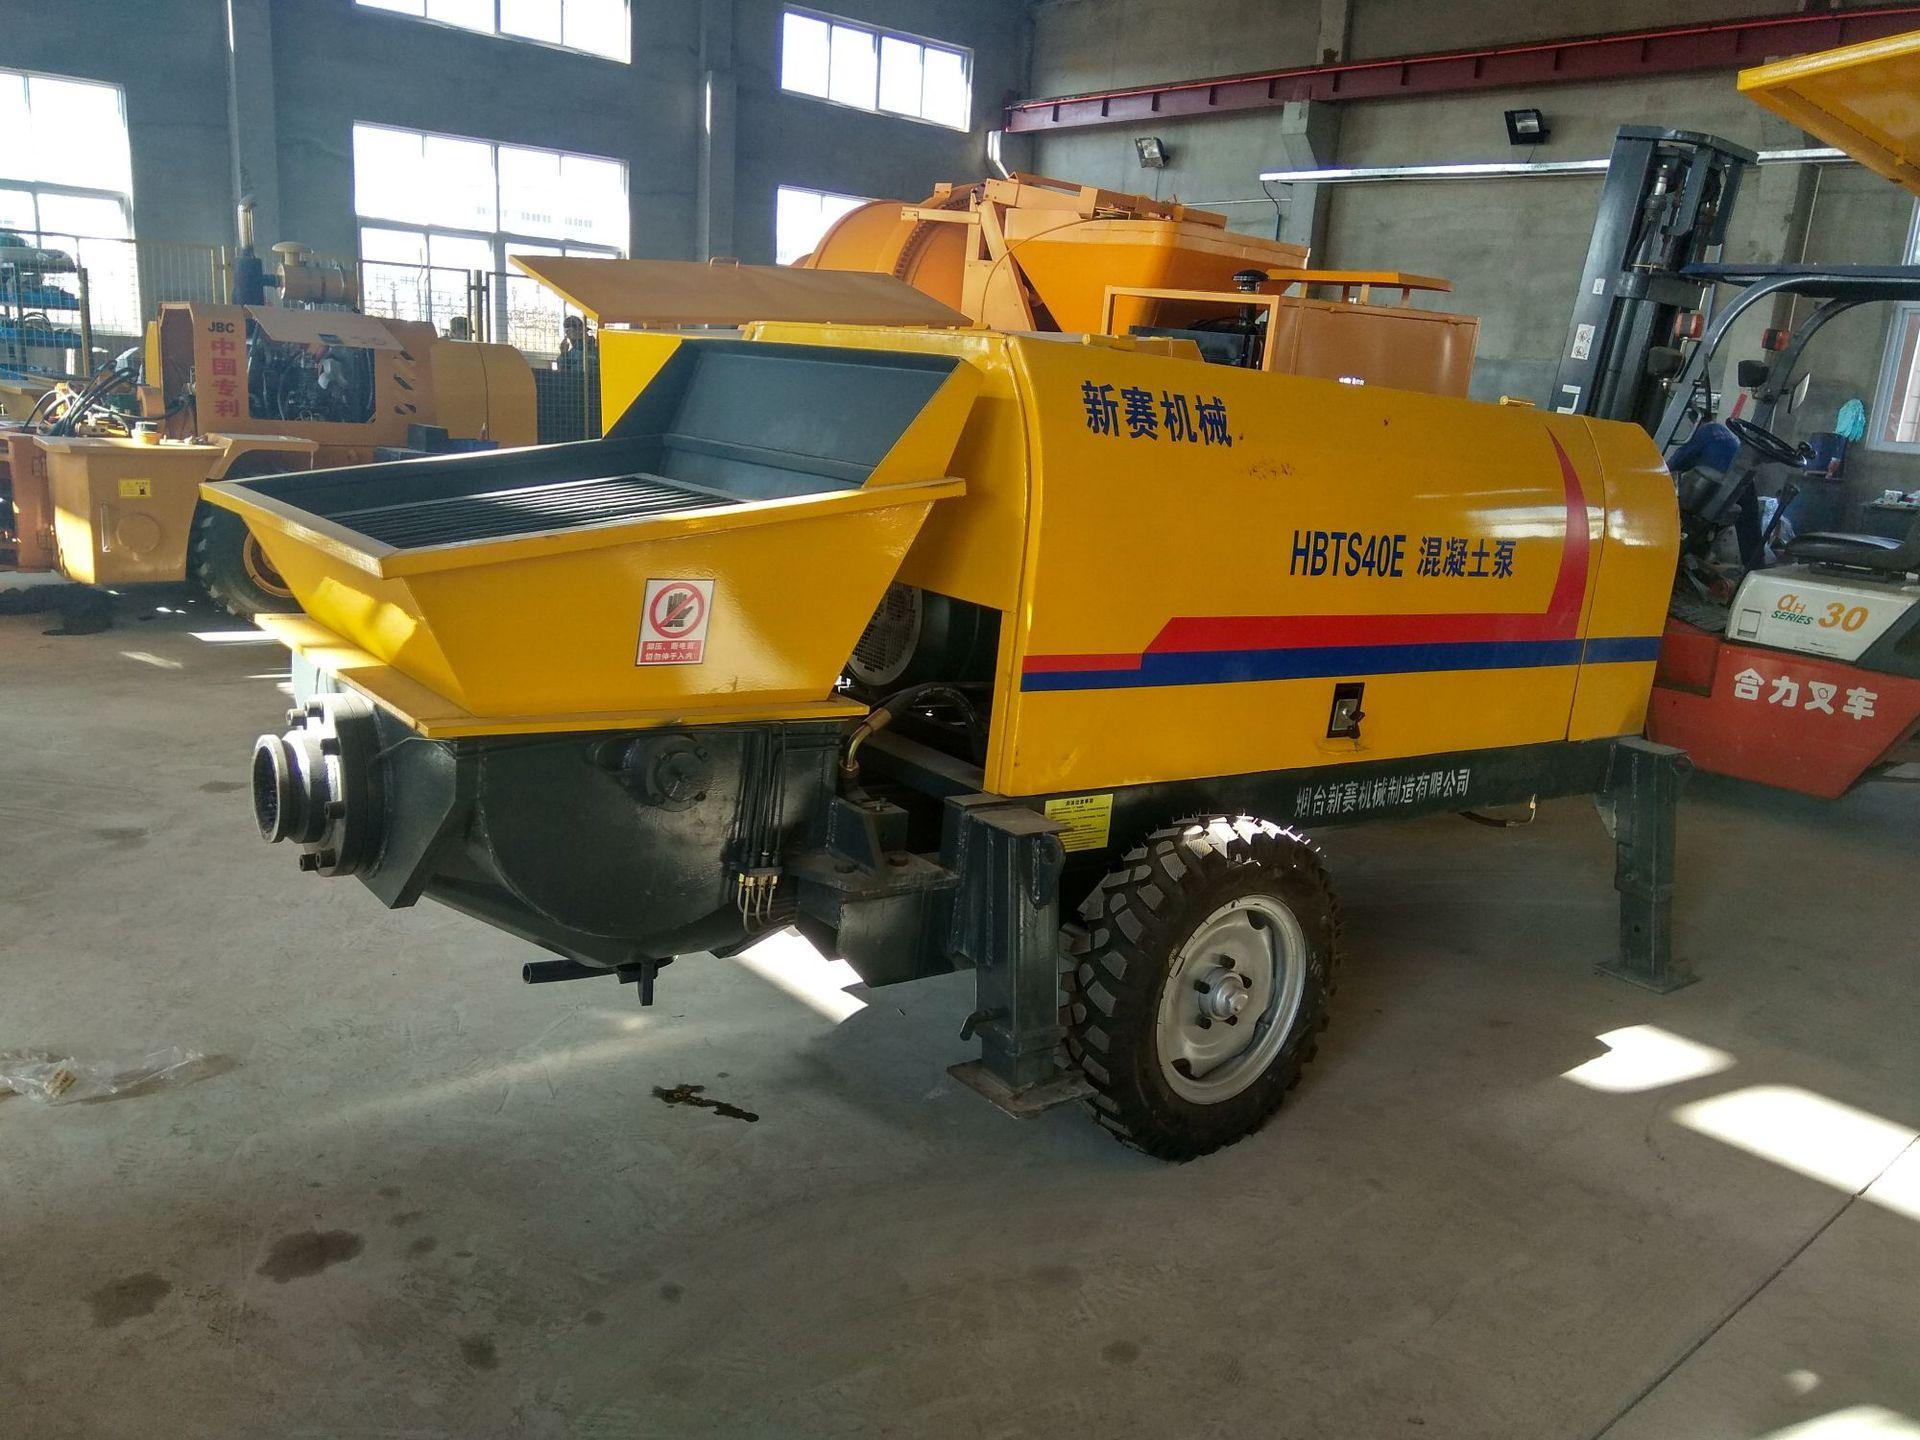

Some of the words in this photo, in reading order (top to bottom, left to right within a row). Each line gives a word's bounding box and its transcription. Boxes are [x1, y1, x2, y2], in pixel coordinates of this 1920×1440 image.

[207, 321, 235, 333] JBC
[211, 338, 240, 418] 中国专利
[1081, 380, 1232, 448] 新赛机械
[1290, 530, 1407, 577] HBTS40E
[1416, 536, 1517, 578] 混凝土泵
[1771, 610, 1813, 625] SERIES
[1818, 602, 1869, 632] 30
[1734, 667, 1878, 720] 合力叉车
[1294, 768, 1471, 818] 烟台新赛机械制造有限公司
